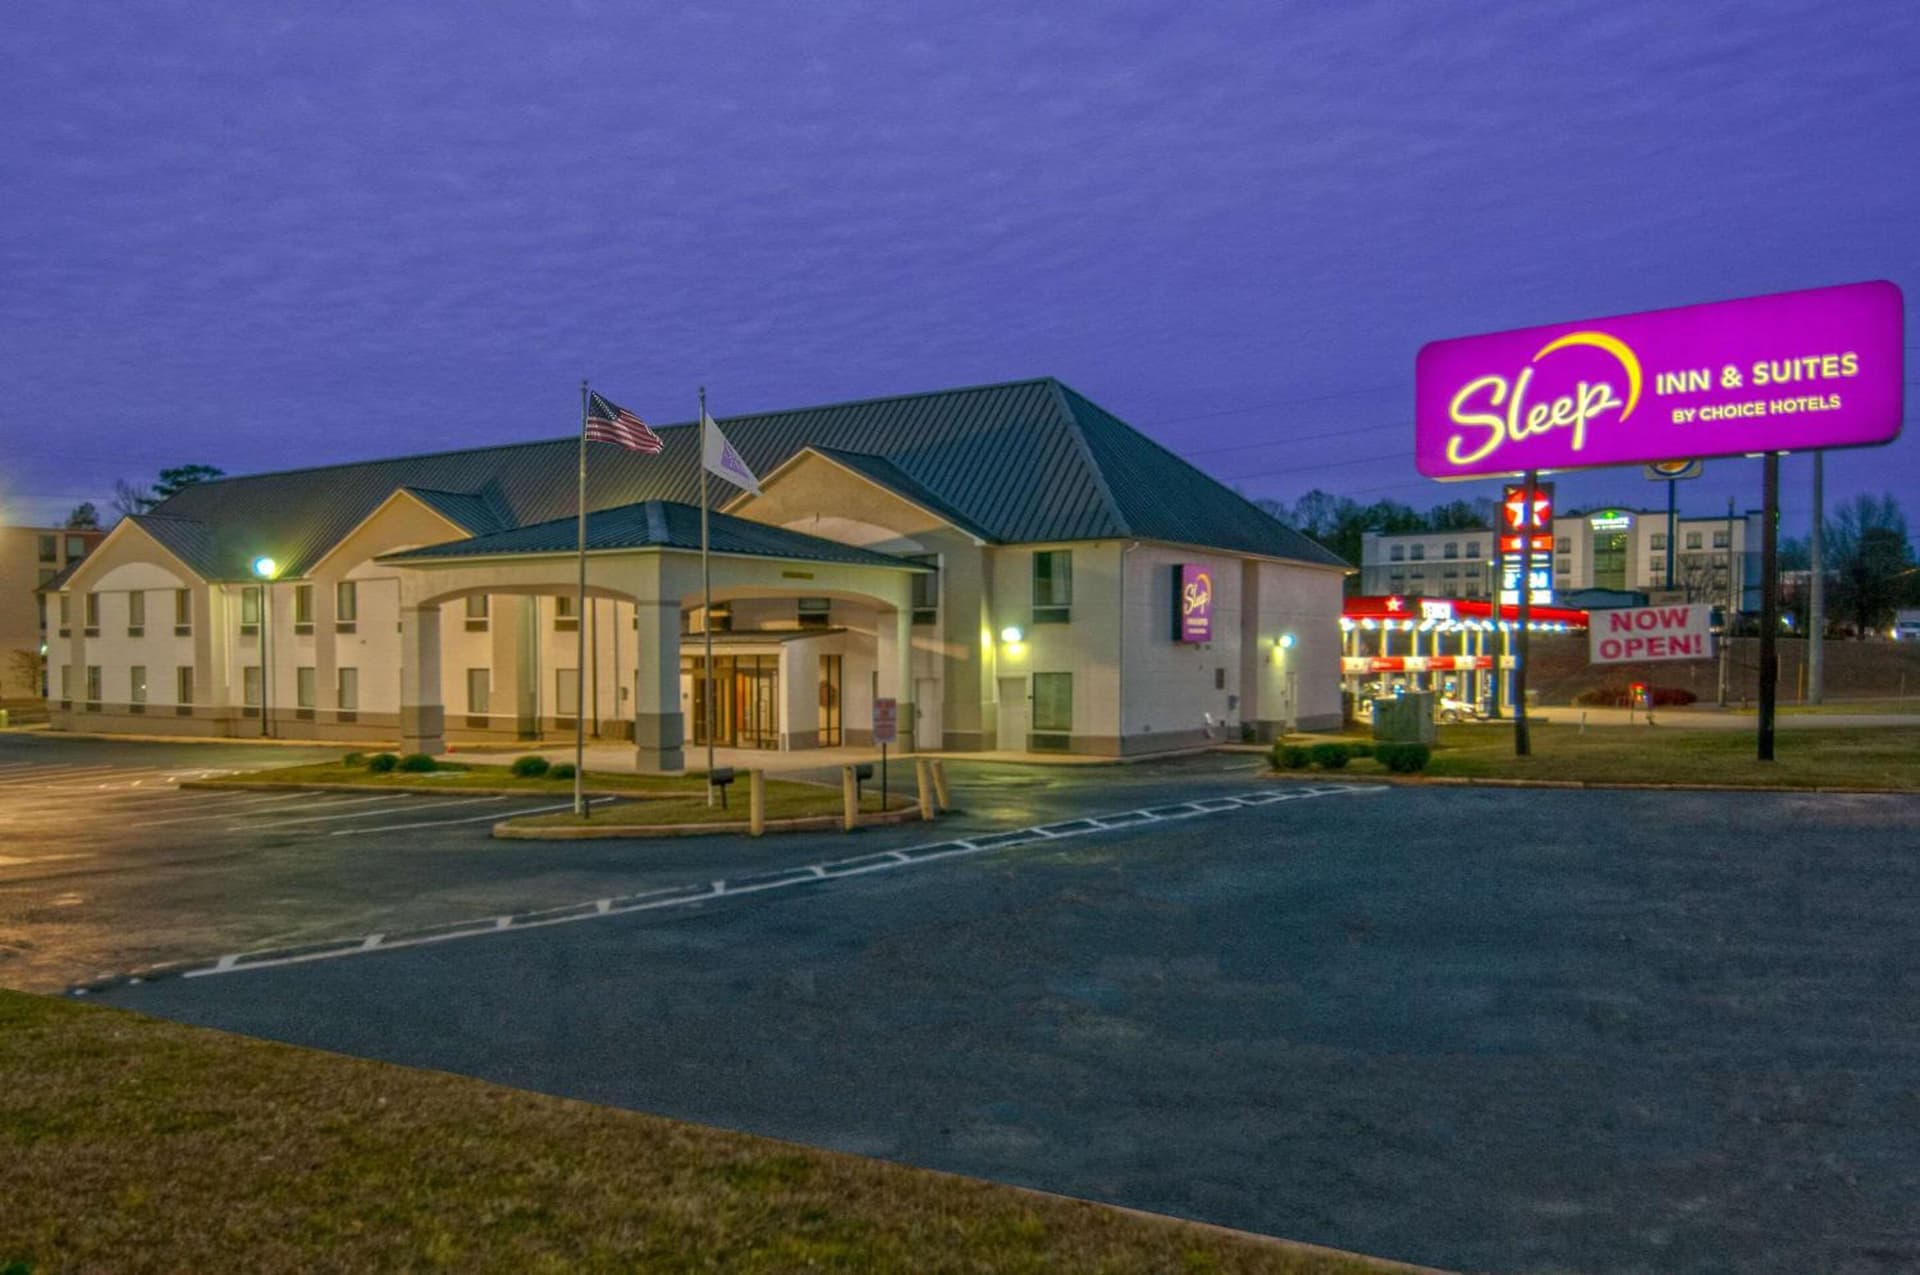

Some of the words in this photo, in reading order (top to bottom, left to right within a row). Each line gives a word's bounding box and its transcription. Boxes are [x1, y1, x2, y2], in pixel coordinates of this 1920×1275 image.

[1656, 368, 1711, 396] INN
[1721, 364, 1744, 389] &
[1752, 351, 1859, 385] SUITES
[1446, 366, 1622, 465] Sleep
[1672, 408, 1696, 424] BY
[1699, 402, 1767, 422] CHOICE
[1770, 394, 1842, 415] HOTELS
[1610, 607, 1690, 633] NOW
[1599, 634, 1702, 659] OPEN!
